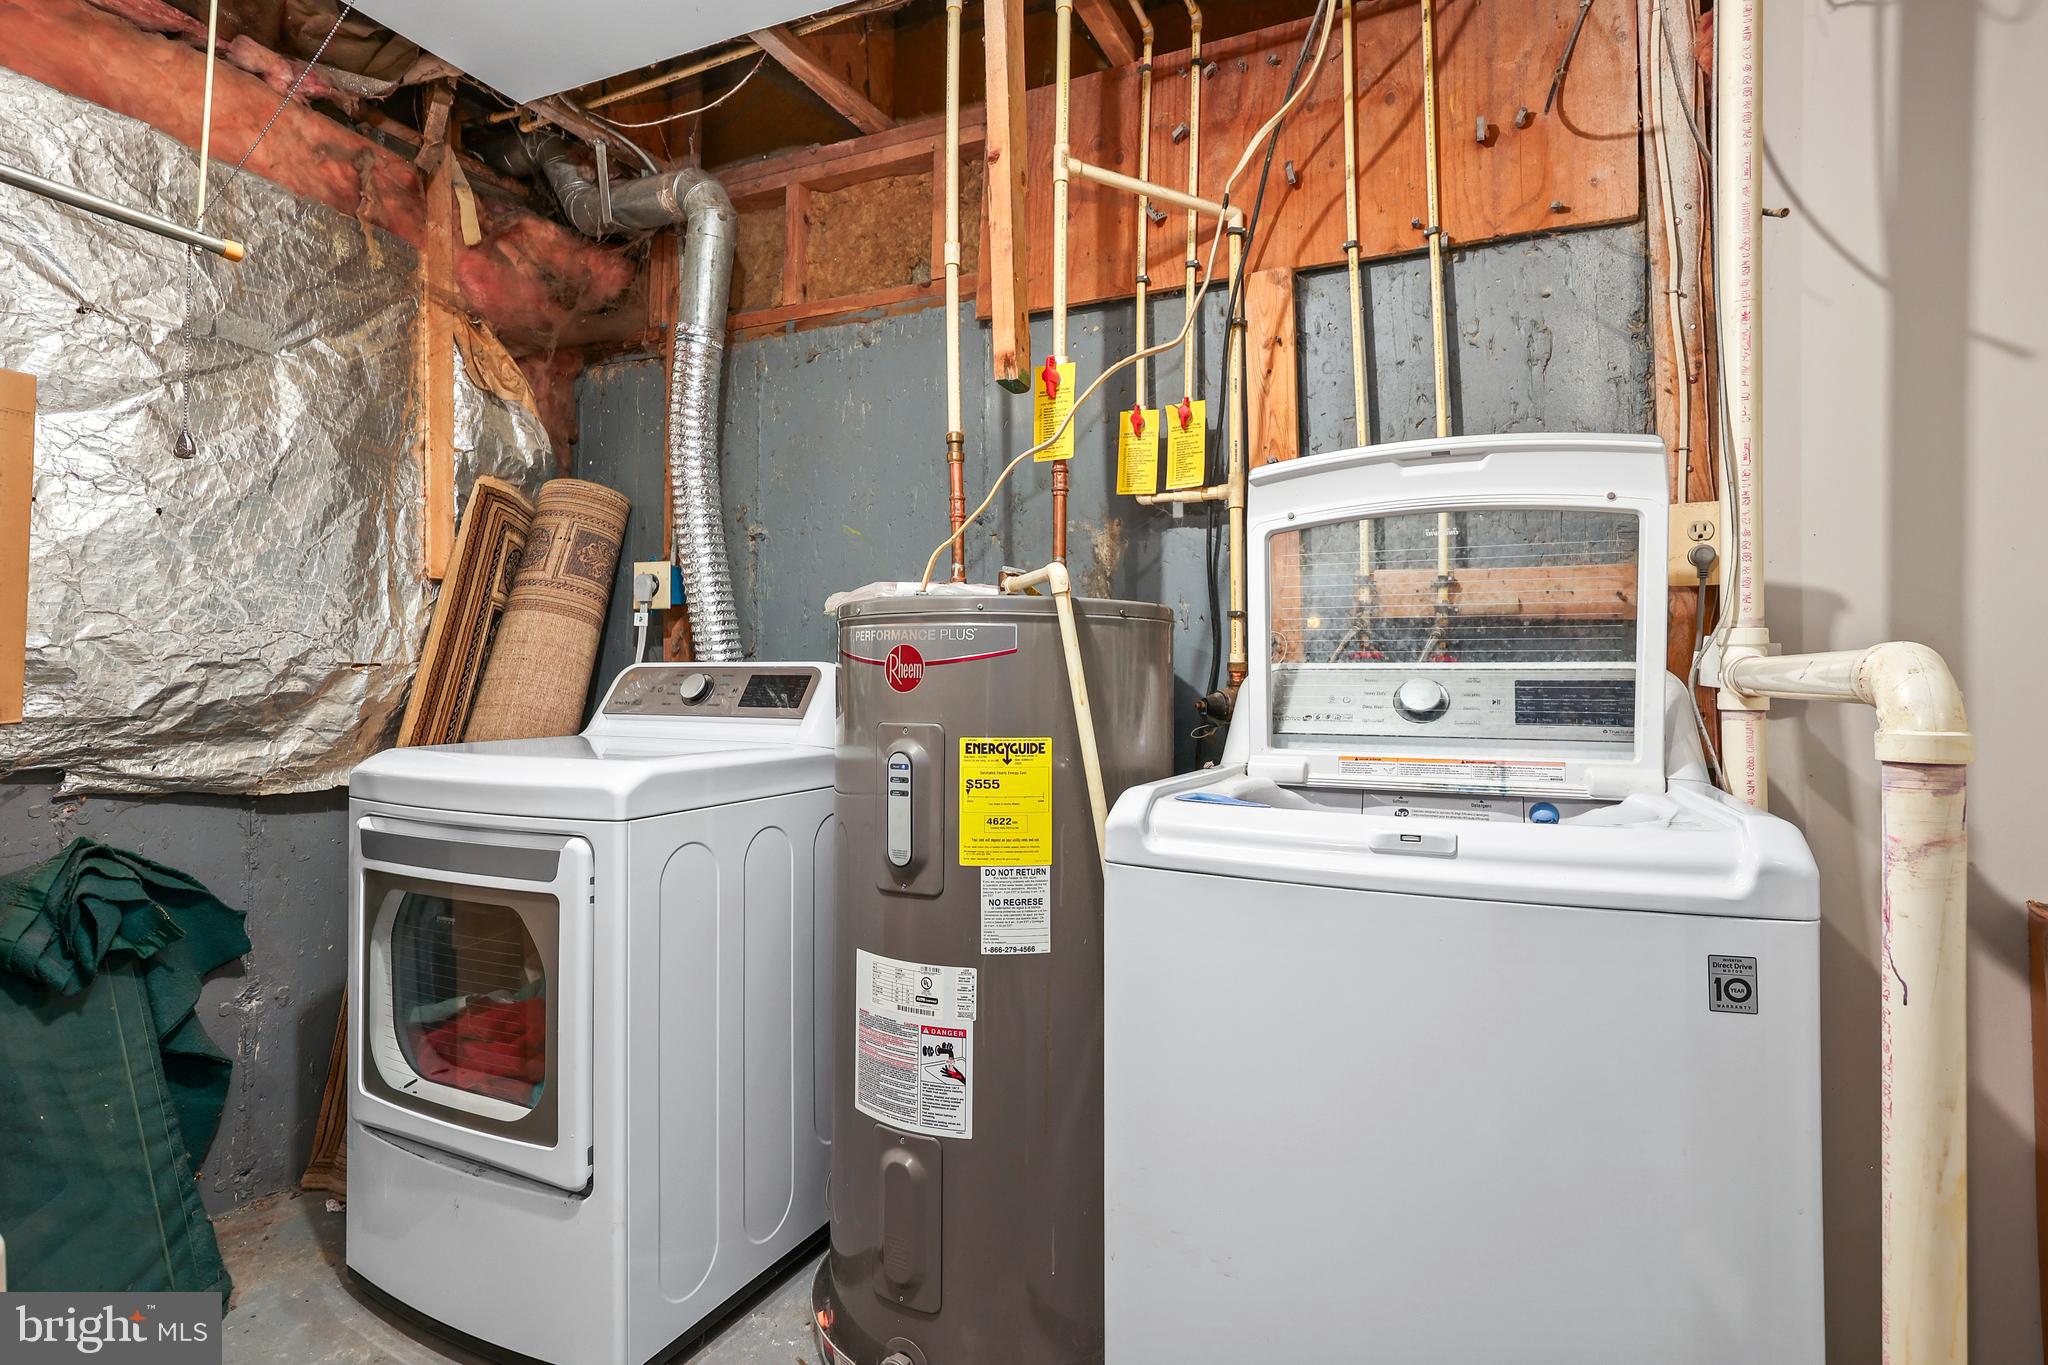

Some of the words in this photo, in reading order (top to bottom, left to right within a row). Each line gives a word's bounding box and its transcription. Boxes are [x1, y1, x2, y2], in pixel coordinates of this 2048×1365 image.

[855, 628, 936, 642] PERFORMANCE
[889, 645, 922, 685] Rheem
[965, 742, 1046, 755] ENERGYGUIDE
[966, 779, 1001, 790] $555
[986, 817, 1012, 826] 4622
[985, 868, 997, 877] DO
[998, 868, 1015, 877] NOT
[1016, 867, 1047, 876] RETURN
[988, 898, 1001, 907] NO
[1003, 898, 1043, 906] REGRESE
[1714, 977, 1752, 1003] 10
[931, 1028, 965, 1038] DANGER
